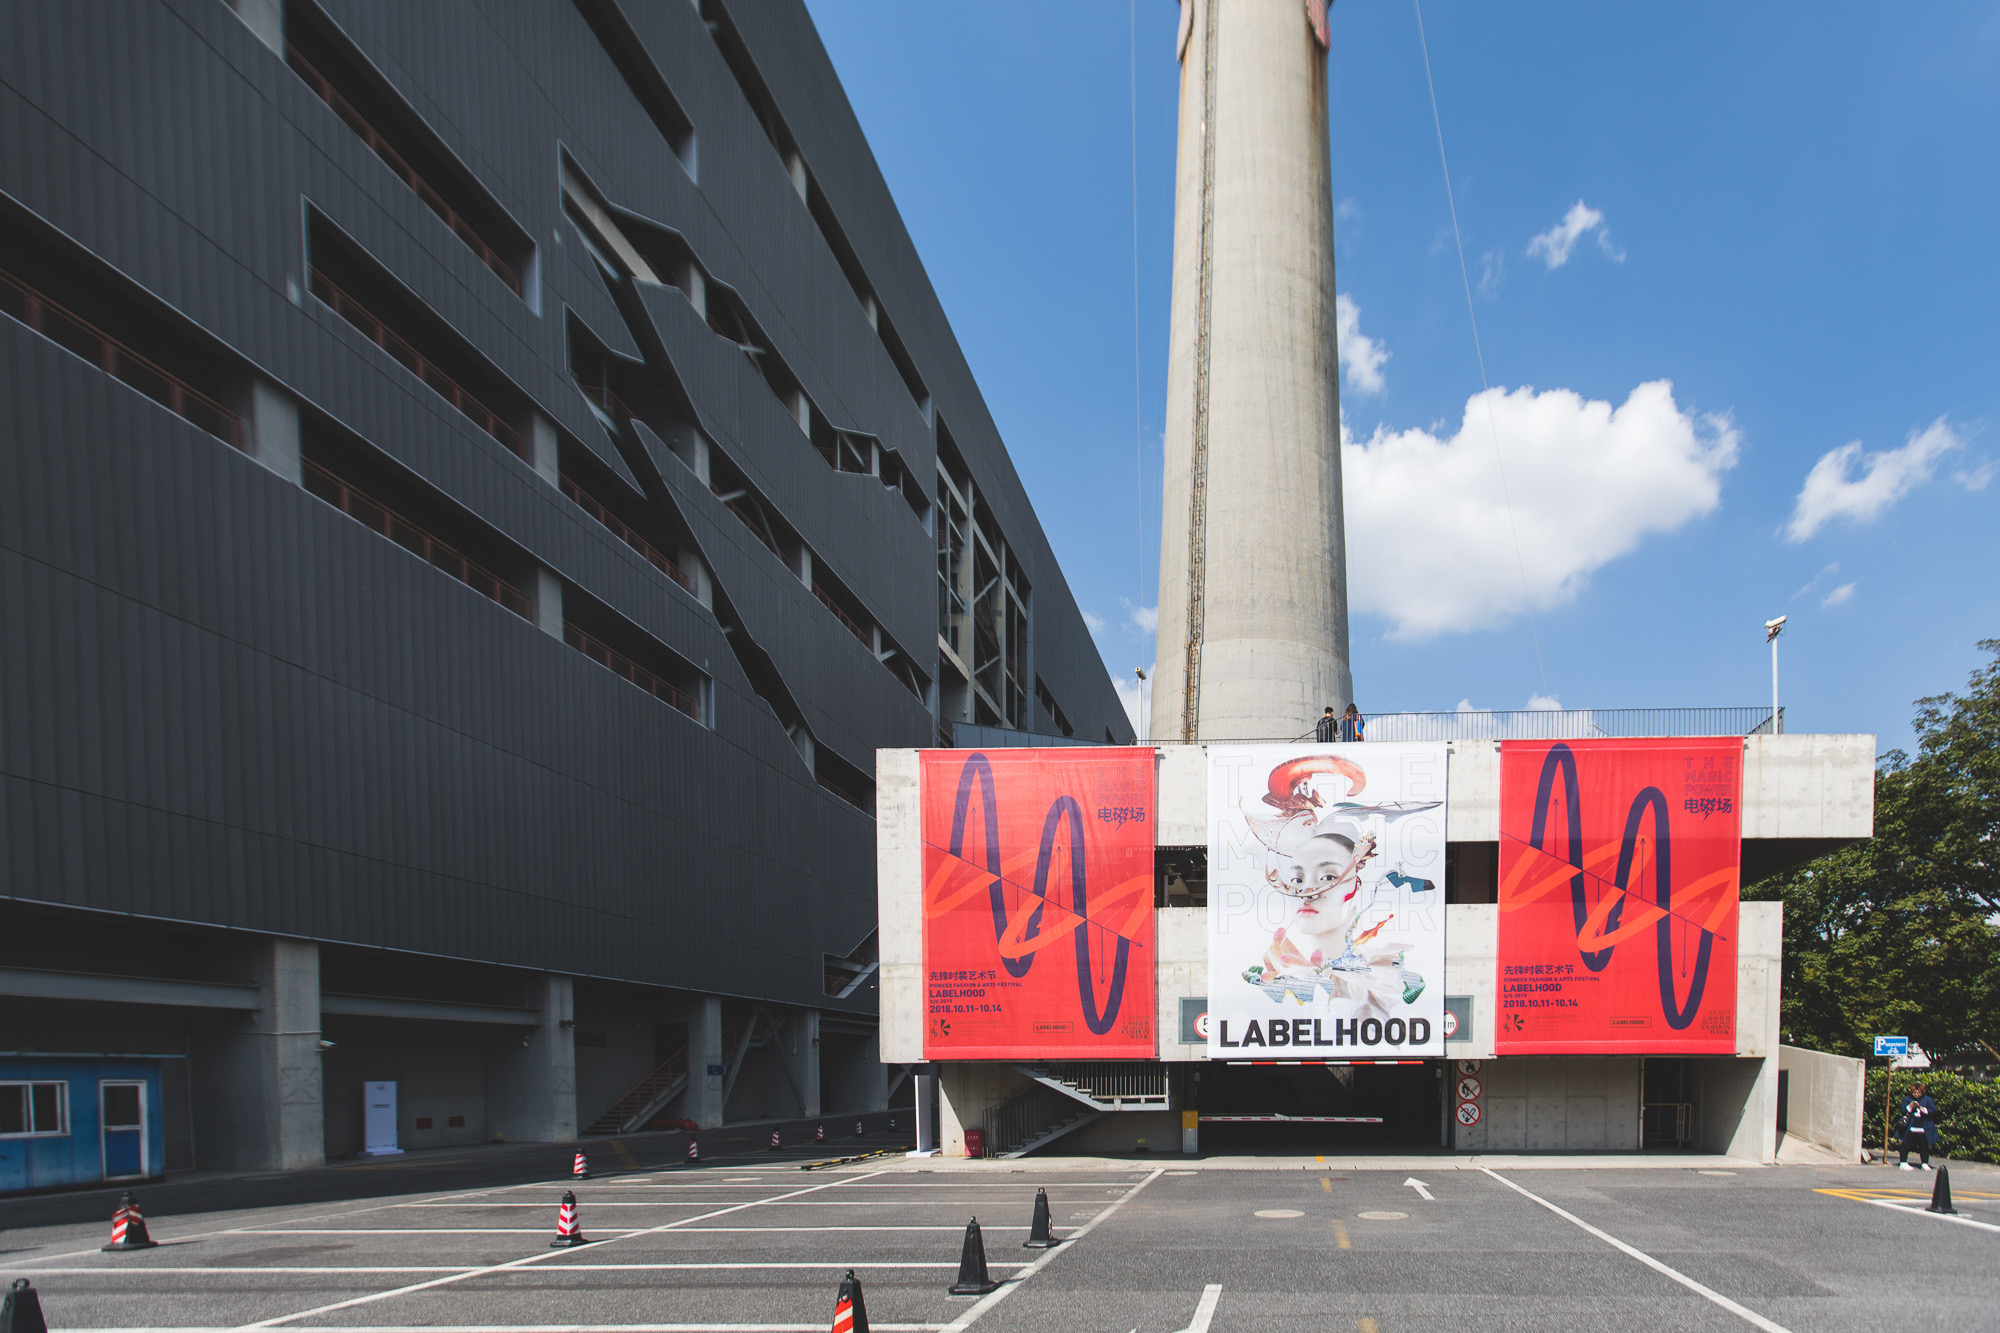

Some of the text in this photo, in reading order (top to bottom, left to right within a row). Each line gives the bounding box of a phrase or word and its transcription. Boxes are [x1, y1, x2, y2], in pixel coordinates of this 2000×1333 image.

[1685, 770, 1733, 782] MAGIC
[1097, 780, 1145, 791] MAGIC
[1685, 784, 1733, 796] POWER
[1097, 793, 1145, 805] POWER
[1684, 798, 1732, 822] 电磁场
[1097, 807, 1145, 831] 电磁场
[1217, 816, 1439, 870] MIC
[1217, 881, 1438, 934] POER
[929, 989, 985, 998] LABELHOOD
[1503, 983, 1562, 992] LABELHOOD
[929, 1004, 1002, 1013] 2018.10.11-10.14
[1503, 999, 1578, 1008] 2018.10.11-10.14
[1220, 1017, 1431, 1048] LABELHOOD
[1876, 1038, 1887, 1051] P
